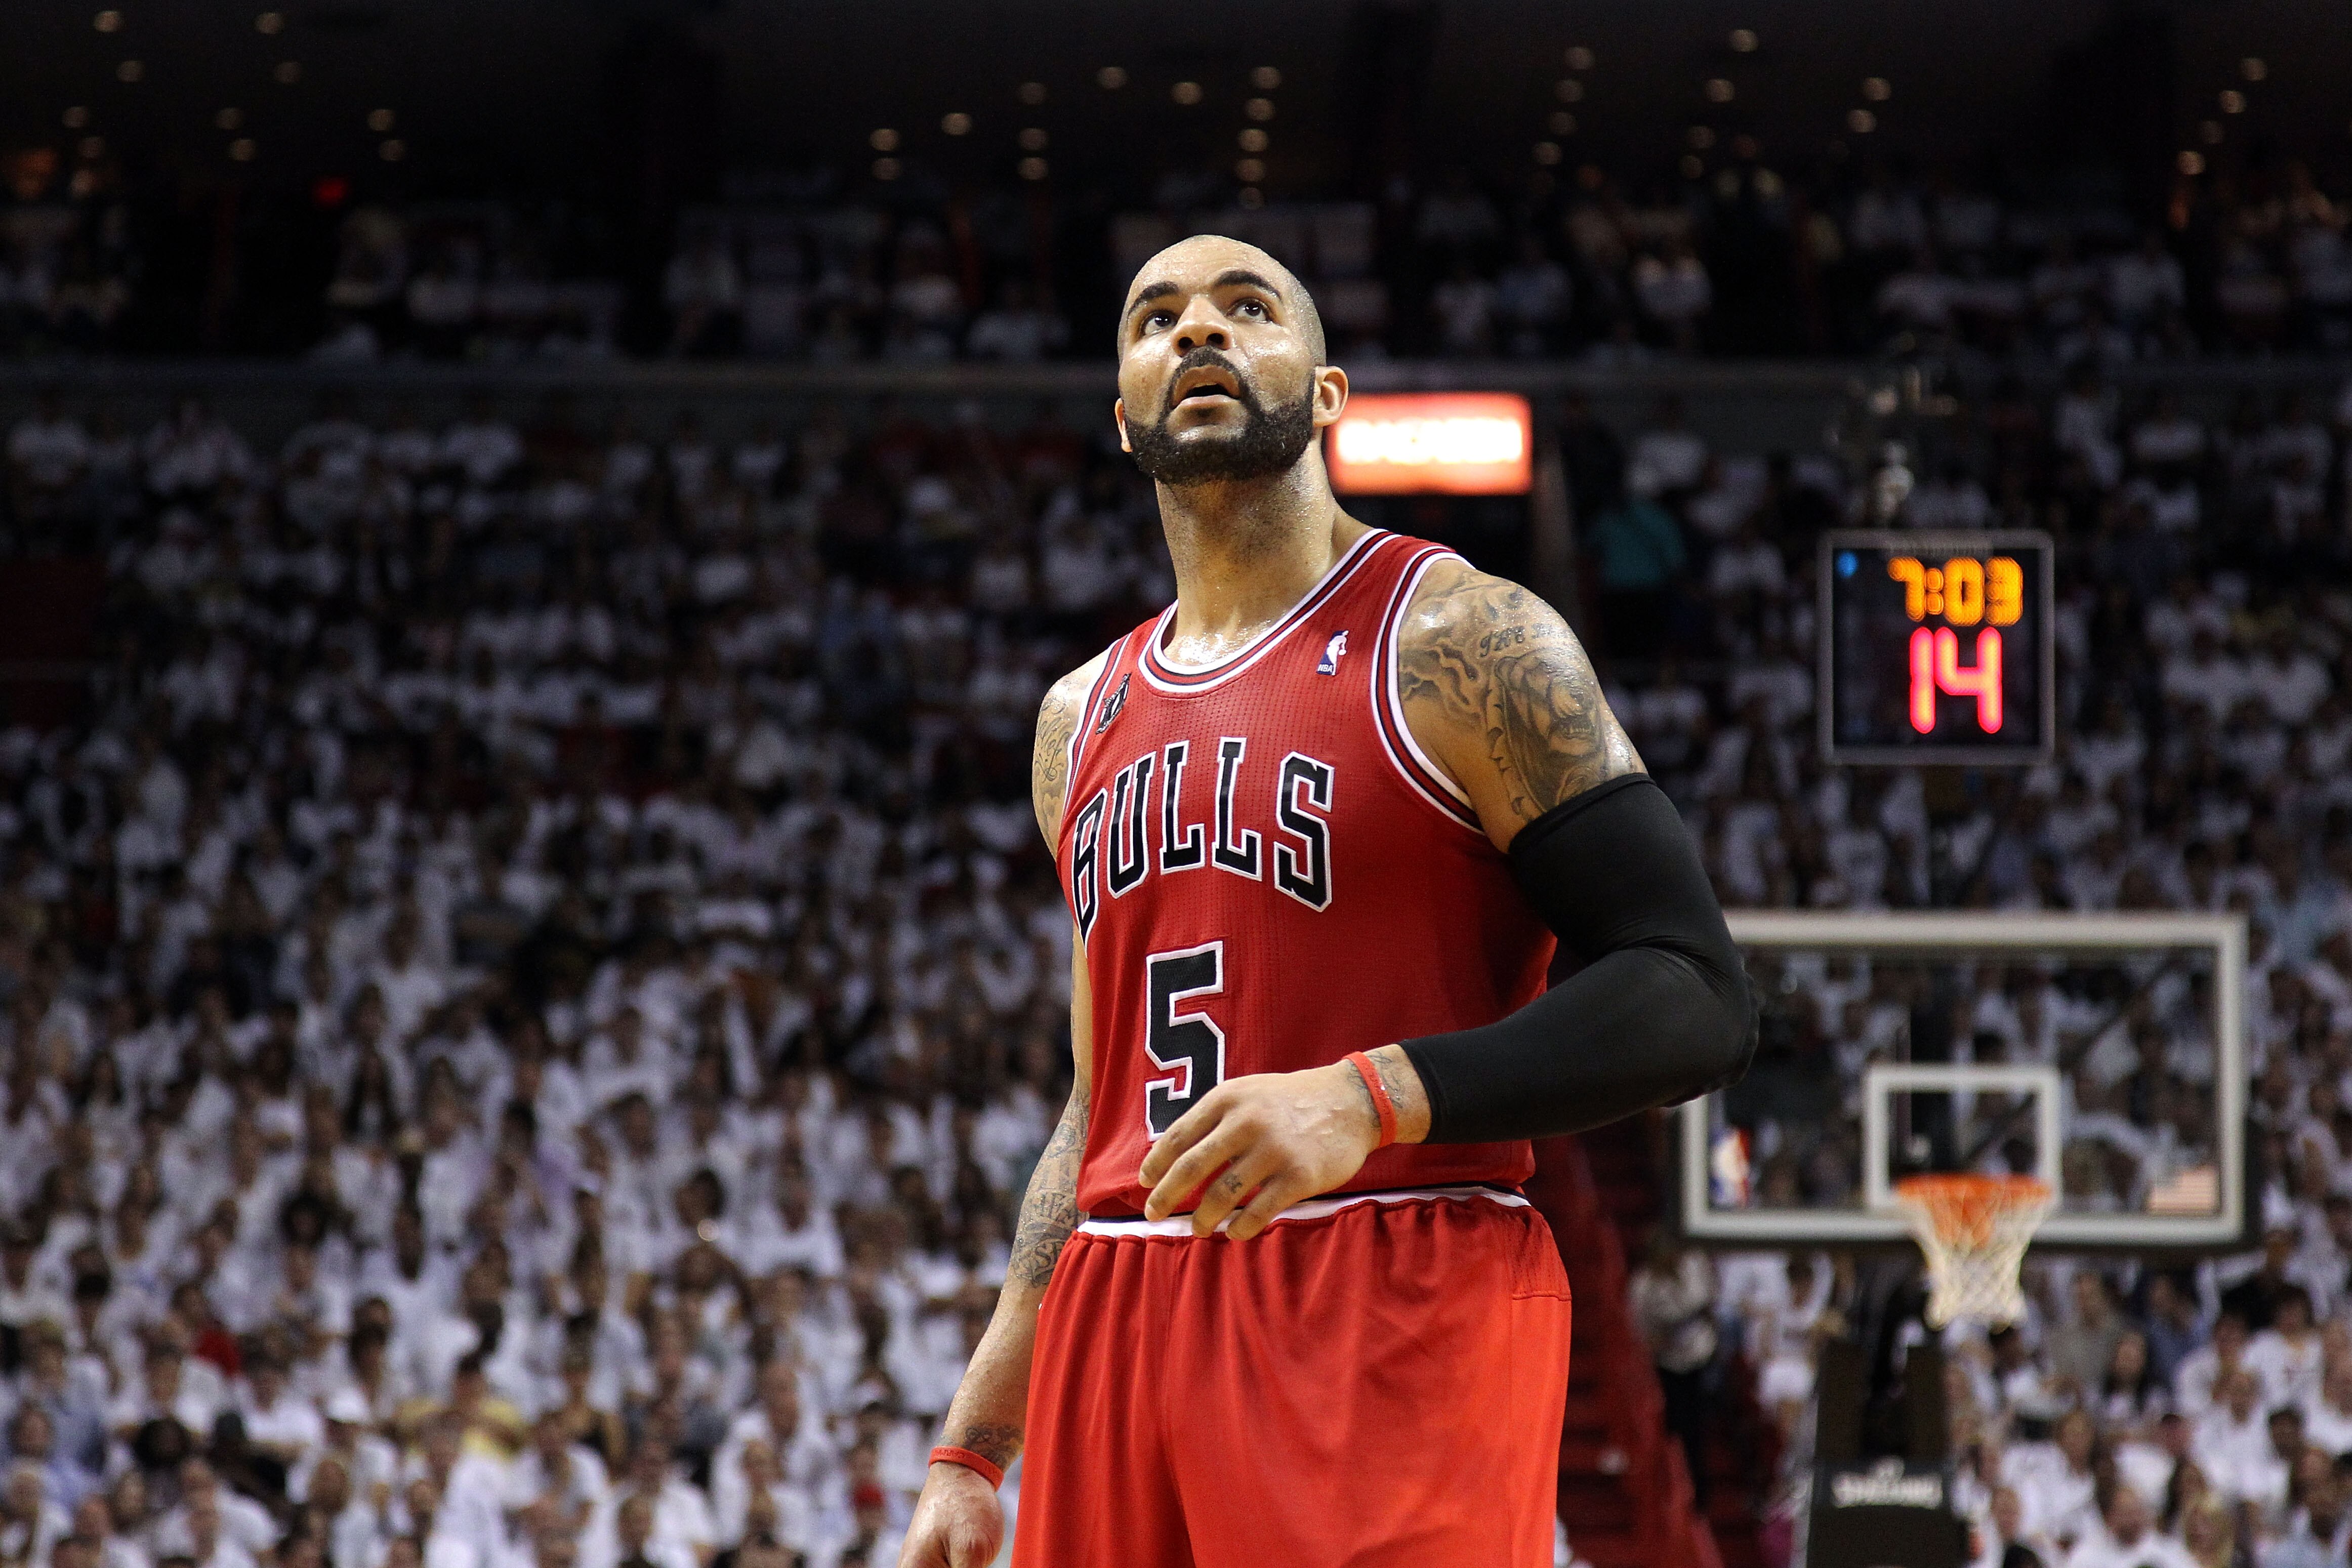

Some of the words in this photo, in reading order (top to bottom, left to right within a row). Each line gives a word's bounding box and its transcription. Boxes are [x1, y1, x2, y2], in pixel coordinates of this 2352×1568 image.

[1887, 556, 2024, 626] 7:03
[1317, 664, 1333, 672] NBA
[1910, 626, 2002, 734] 14
[1071, 736, 1335, 948] BULLS
[1145, 940, 1225, 1141] 5
